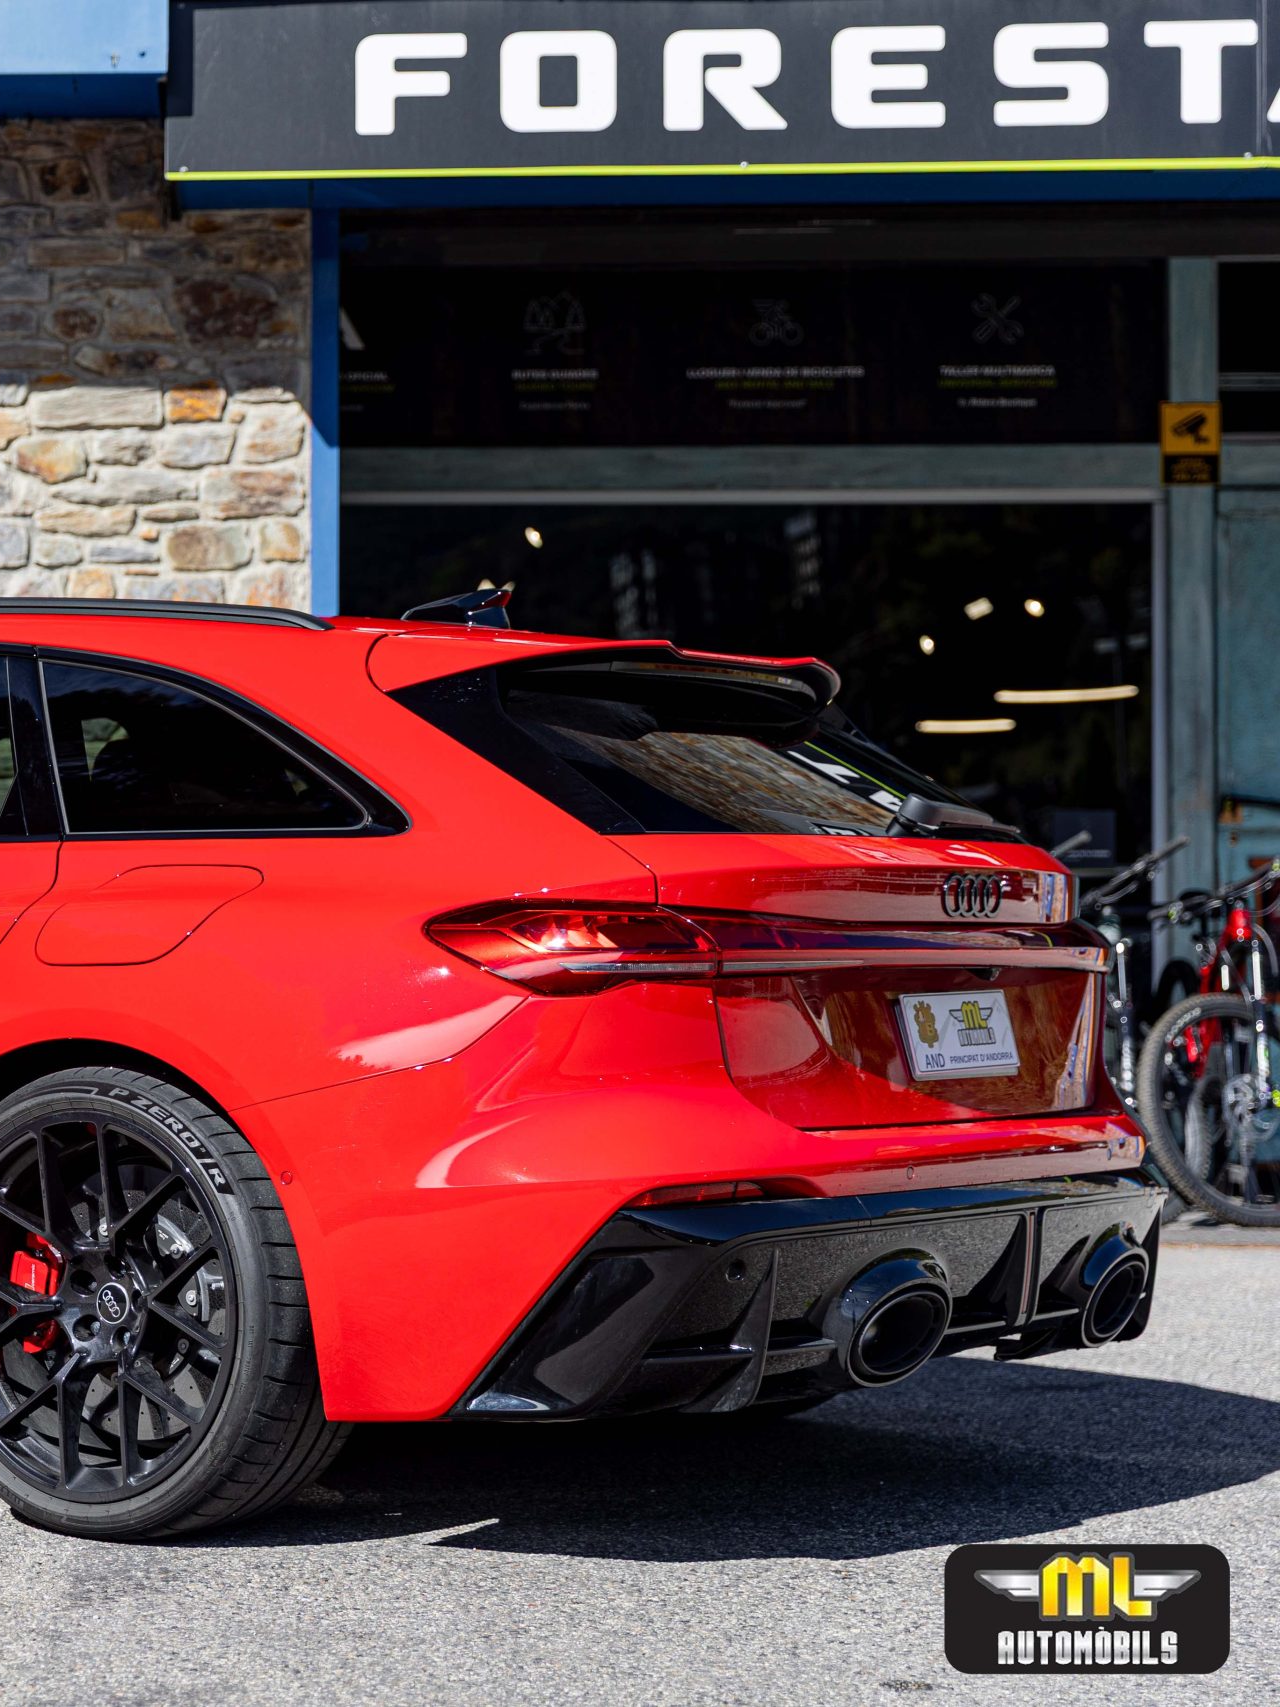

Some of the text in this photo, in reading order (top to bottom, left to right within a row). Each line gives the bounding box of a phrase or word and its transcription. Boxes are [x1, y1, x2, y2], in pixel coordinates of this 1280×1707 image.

[355, 19, 1280, 137] FOREST
[960, 1001, 988, 1028] ML
[925, 1051, 1014, 1069] AND PRINCIPAT D'ANDORRA
[108, 1087, 130, 1097] P
[130, 1094, 202, 1149] ZERO
